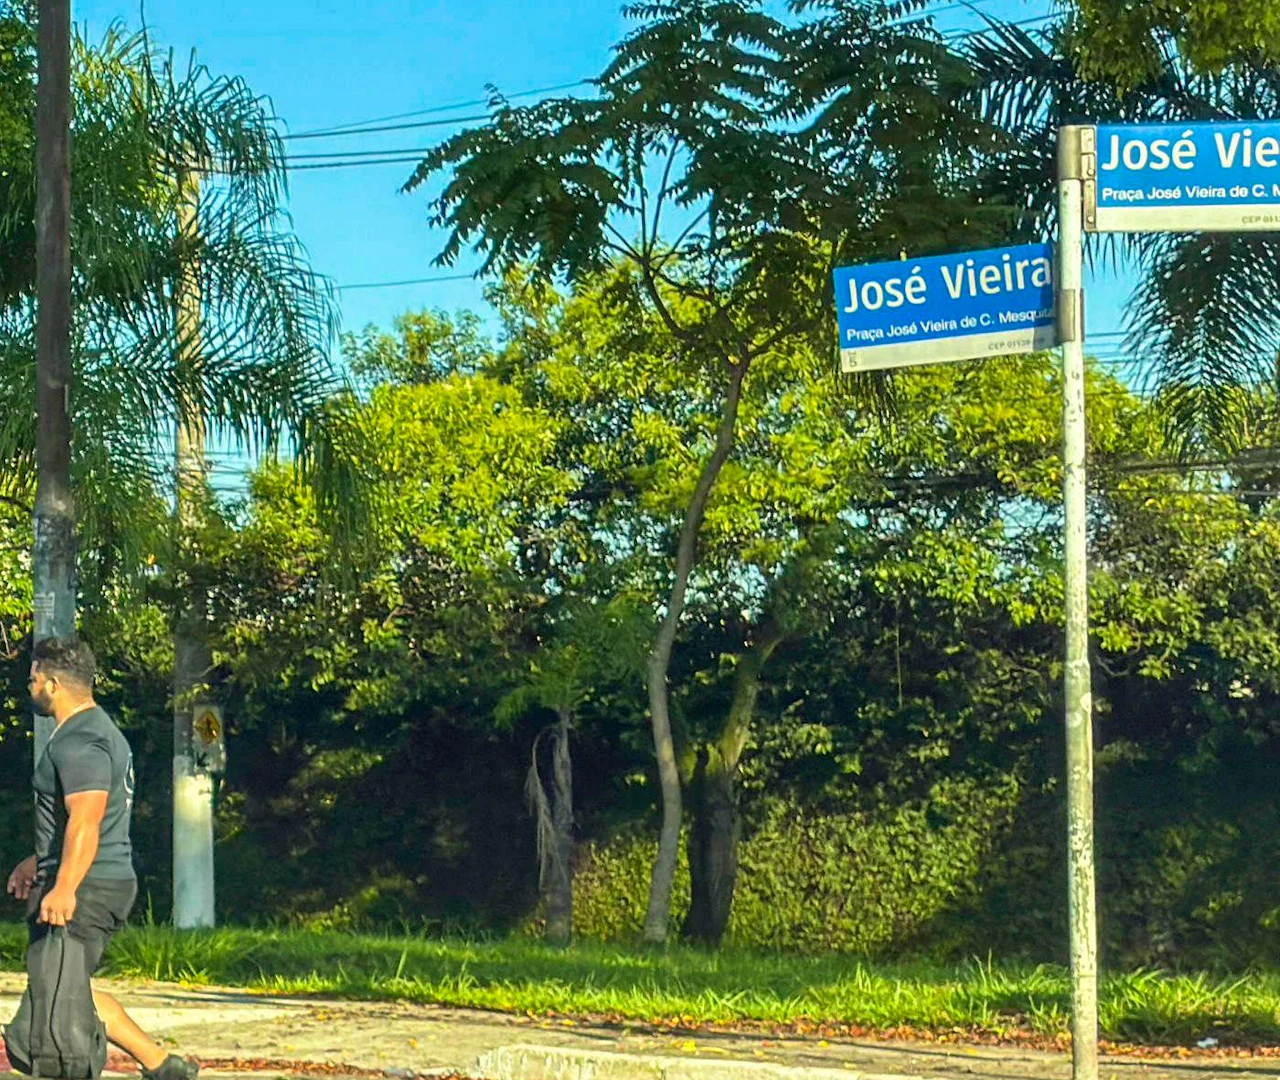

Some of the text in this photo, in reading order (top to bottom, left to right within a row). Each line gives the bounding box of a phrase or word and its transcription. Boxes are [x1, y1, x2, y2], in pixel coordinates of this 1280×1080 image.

[1102, 128, 1280, 171] José Vie
[1102, 187, 1144, 203] Praça
[1147, 185, 1181, 200] José
[1185, 184, 1226, 199] Vieira
[1229, 184, 1248, 198] de
[1251, 183, 1269, 197] C.
[844, 253, 1052, 314] José Vieira
[846, 325, 884, 343] Praça
[887, 320, 918, 338] José
[920, 316, 957, 334] Vieira
[960, 314, 977, 329] de
[979, 313, 995, 327] C.
